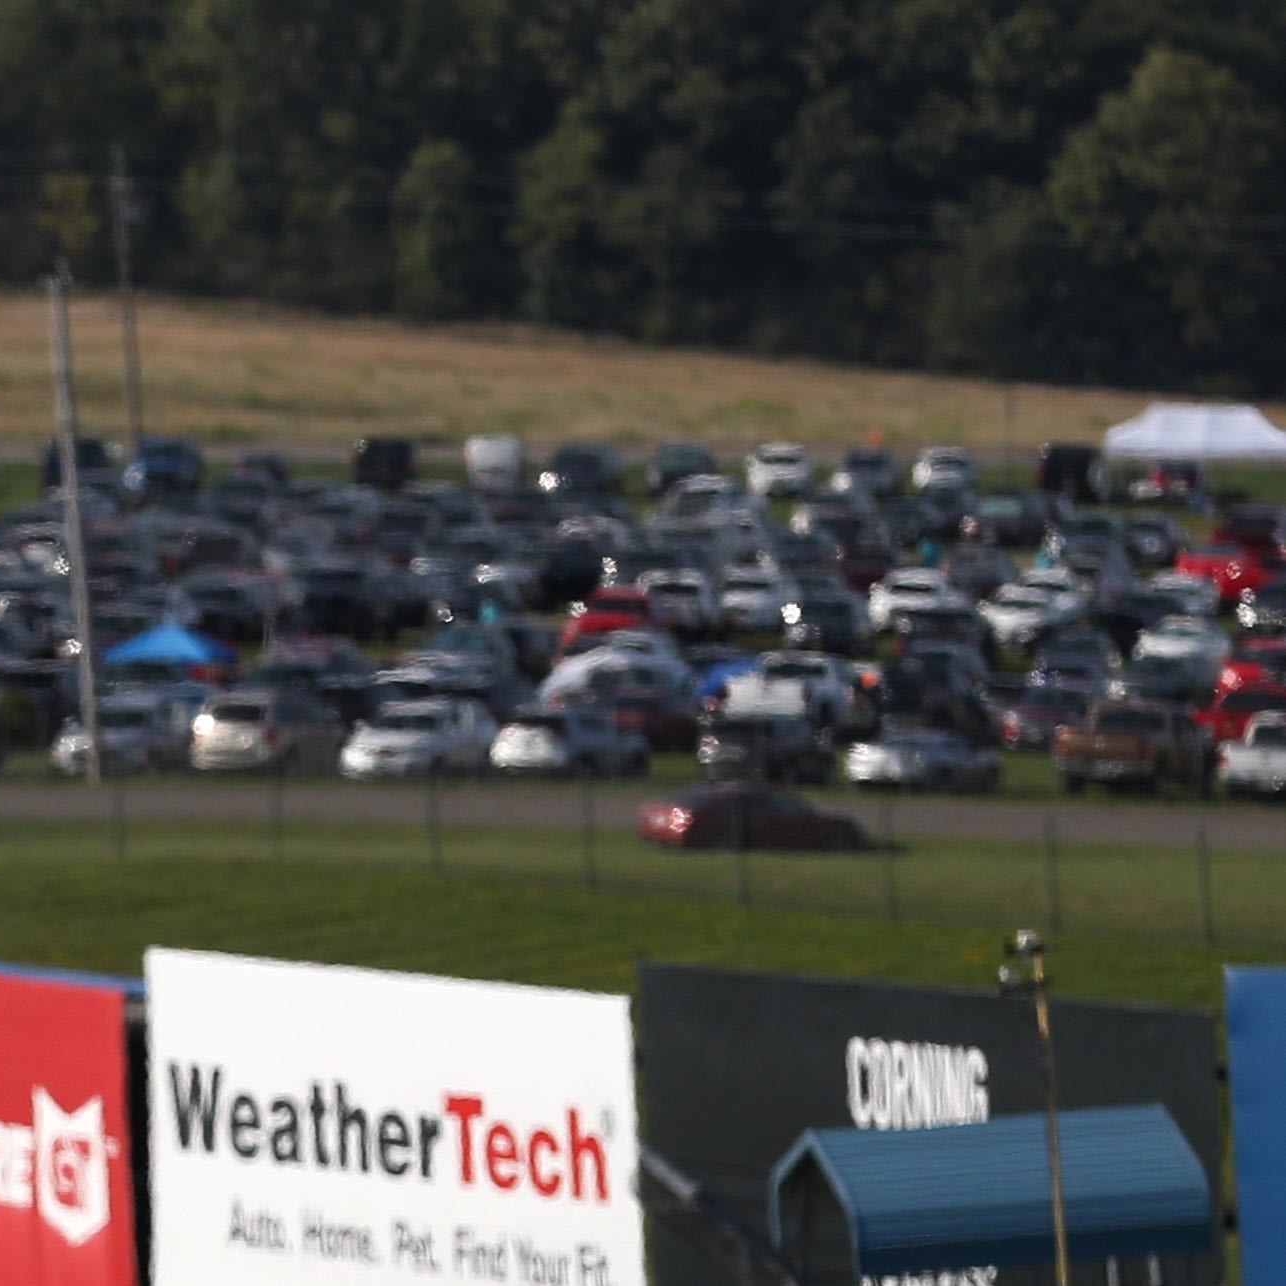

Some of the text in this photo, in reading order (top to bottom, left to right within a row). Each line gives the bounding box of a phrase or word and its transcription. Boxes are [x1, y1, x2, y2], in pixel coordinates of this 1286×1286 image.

[846, 1036, 989, 1131] CORNING
[167, 1058, 609, 1205] WeatherTech
[301, 1209, 382, 1263] Home.
[454, 1226, 508, 1282] Find
